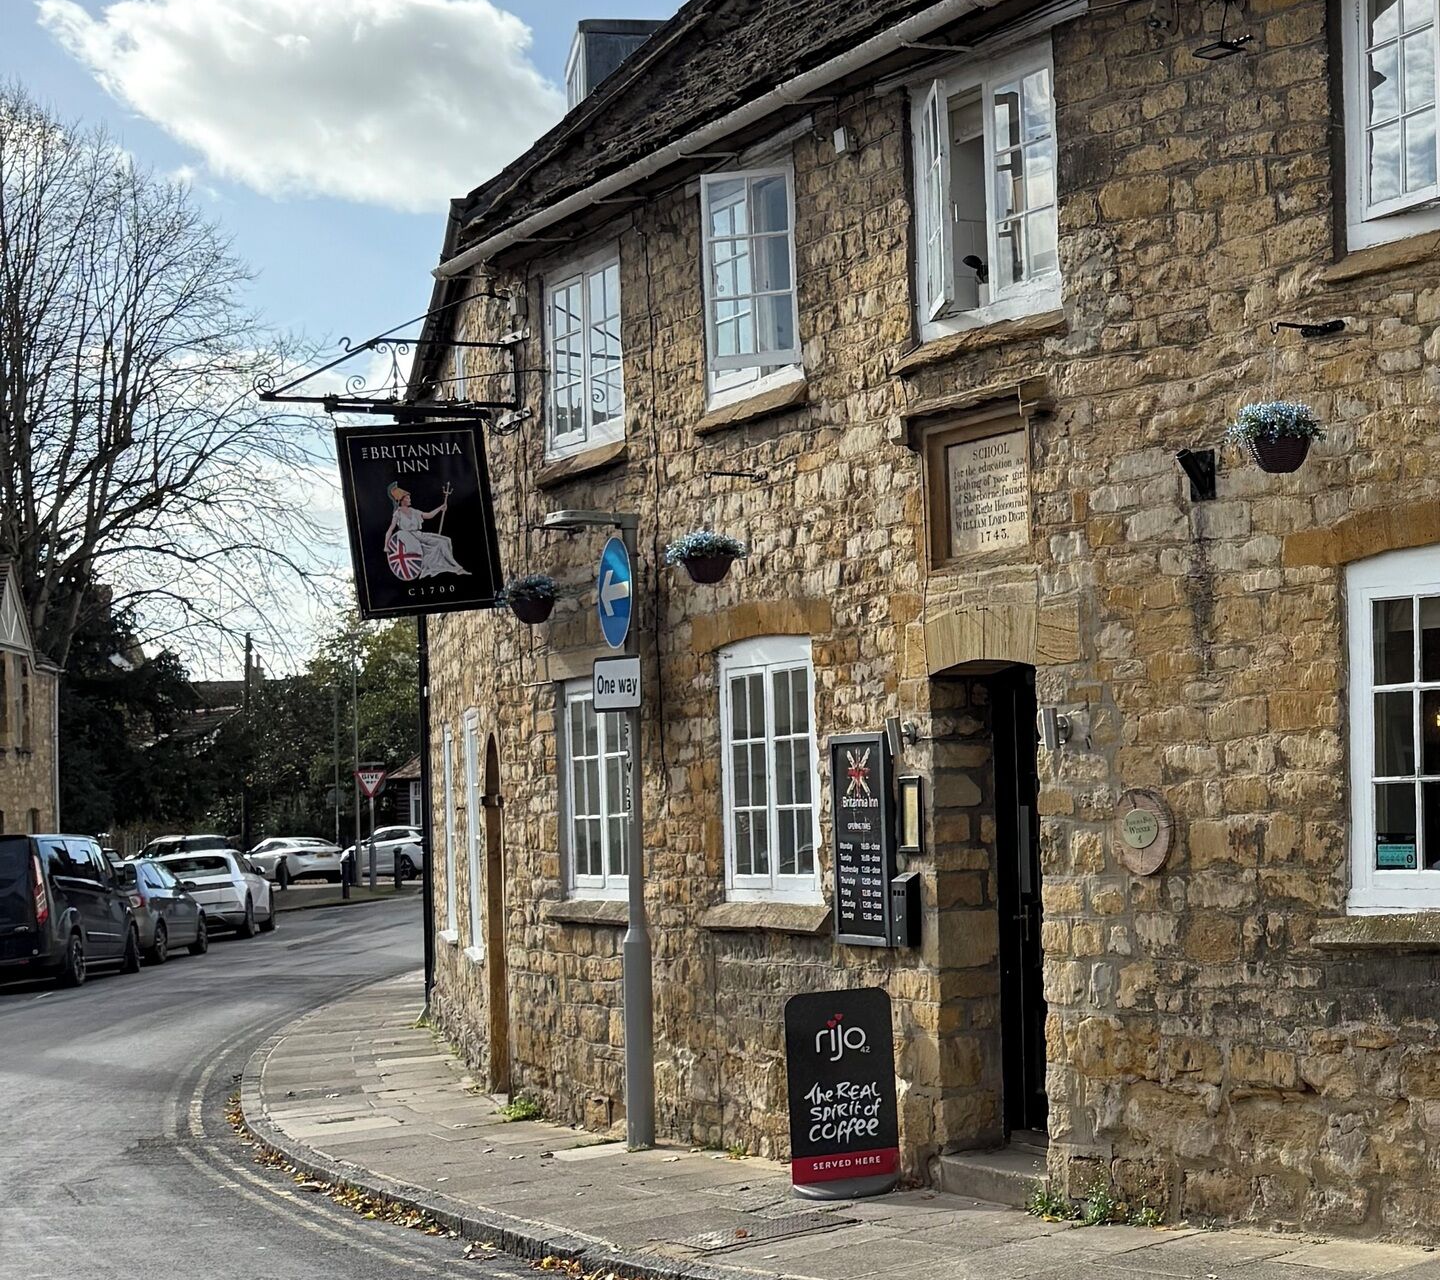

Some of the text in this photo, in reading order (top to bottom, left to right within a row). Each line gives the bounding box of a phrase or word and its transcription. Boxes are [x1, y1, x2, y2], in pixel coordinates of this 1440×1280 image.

[370, 442, 463, 460] BRITANNIA
[972, 442, 1010, 461] SCHOOL
[396, 458, 430, 473] INN
[978, 458, 1012, 474] education
[955, 478, 982, 493] clothing
[983, 474, 992, 486] of
[993, 474, 1009, 488] poor
[964, 505, 974, 517] the
[975, 502, 993, 516] Right
[955, 519, 987, 531] WILLIAM
[988, 515, 1008, 526] LORD
[597, 674, 638, 697] One way
[842, 795, 879, 808] Britannia Inn
[815, 1024, 871, 1062] rijo 42
[836, 1081, 881, 1101] REAL
[863, 1097, 882, 1118] of
[812, 1155, 881, 1170] SERVED HERE
